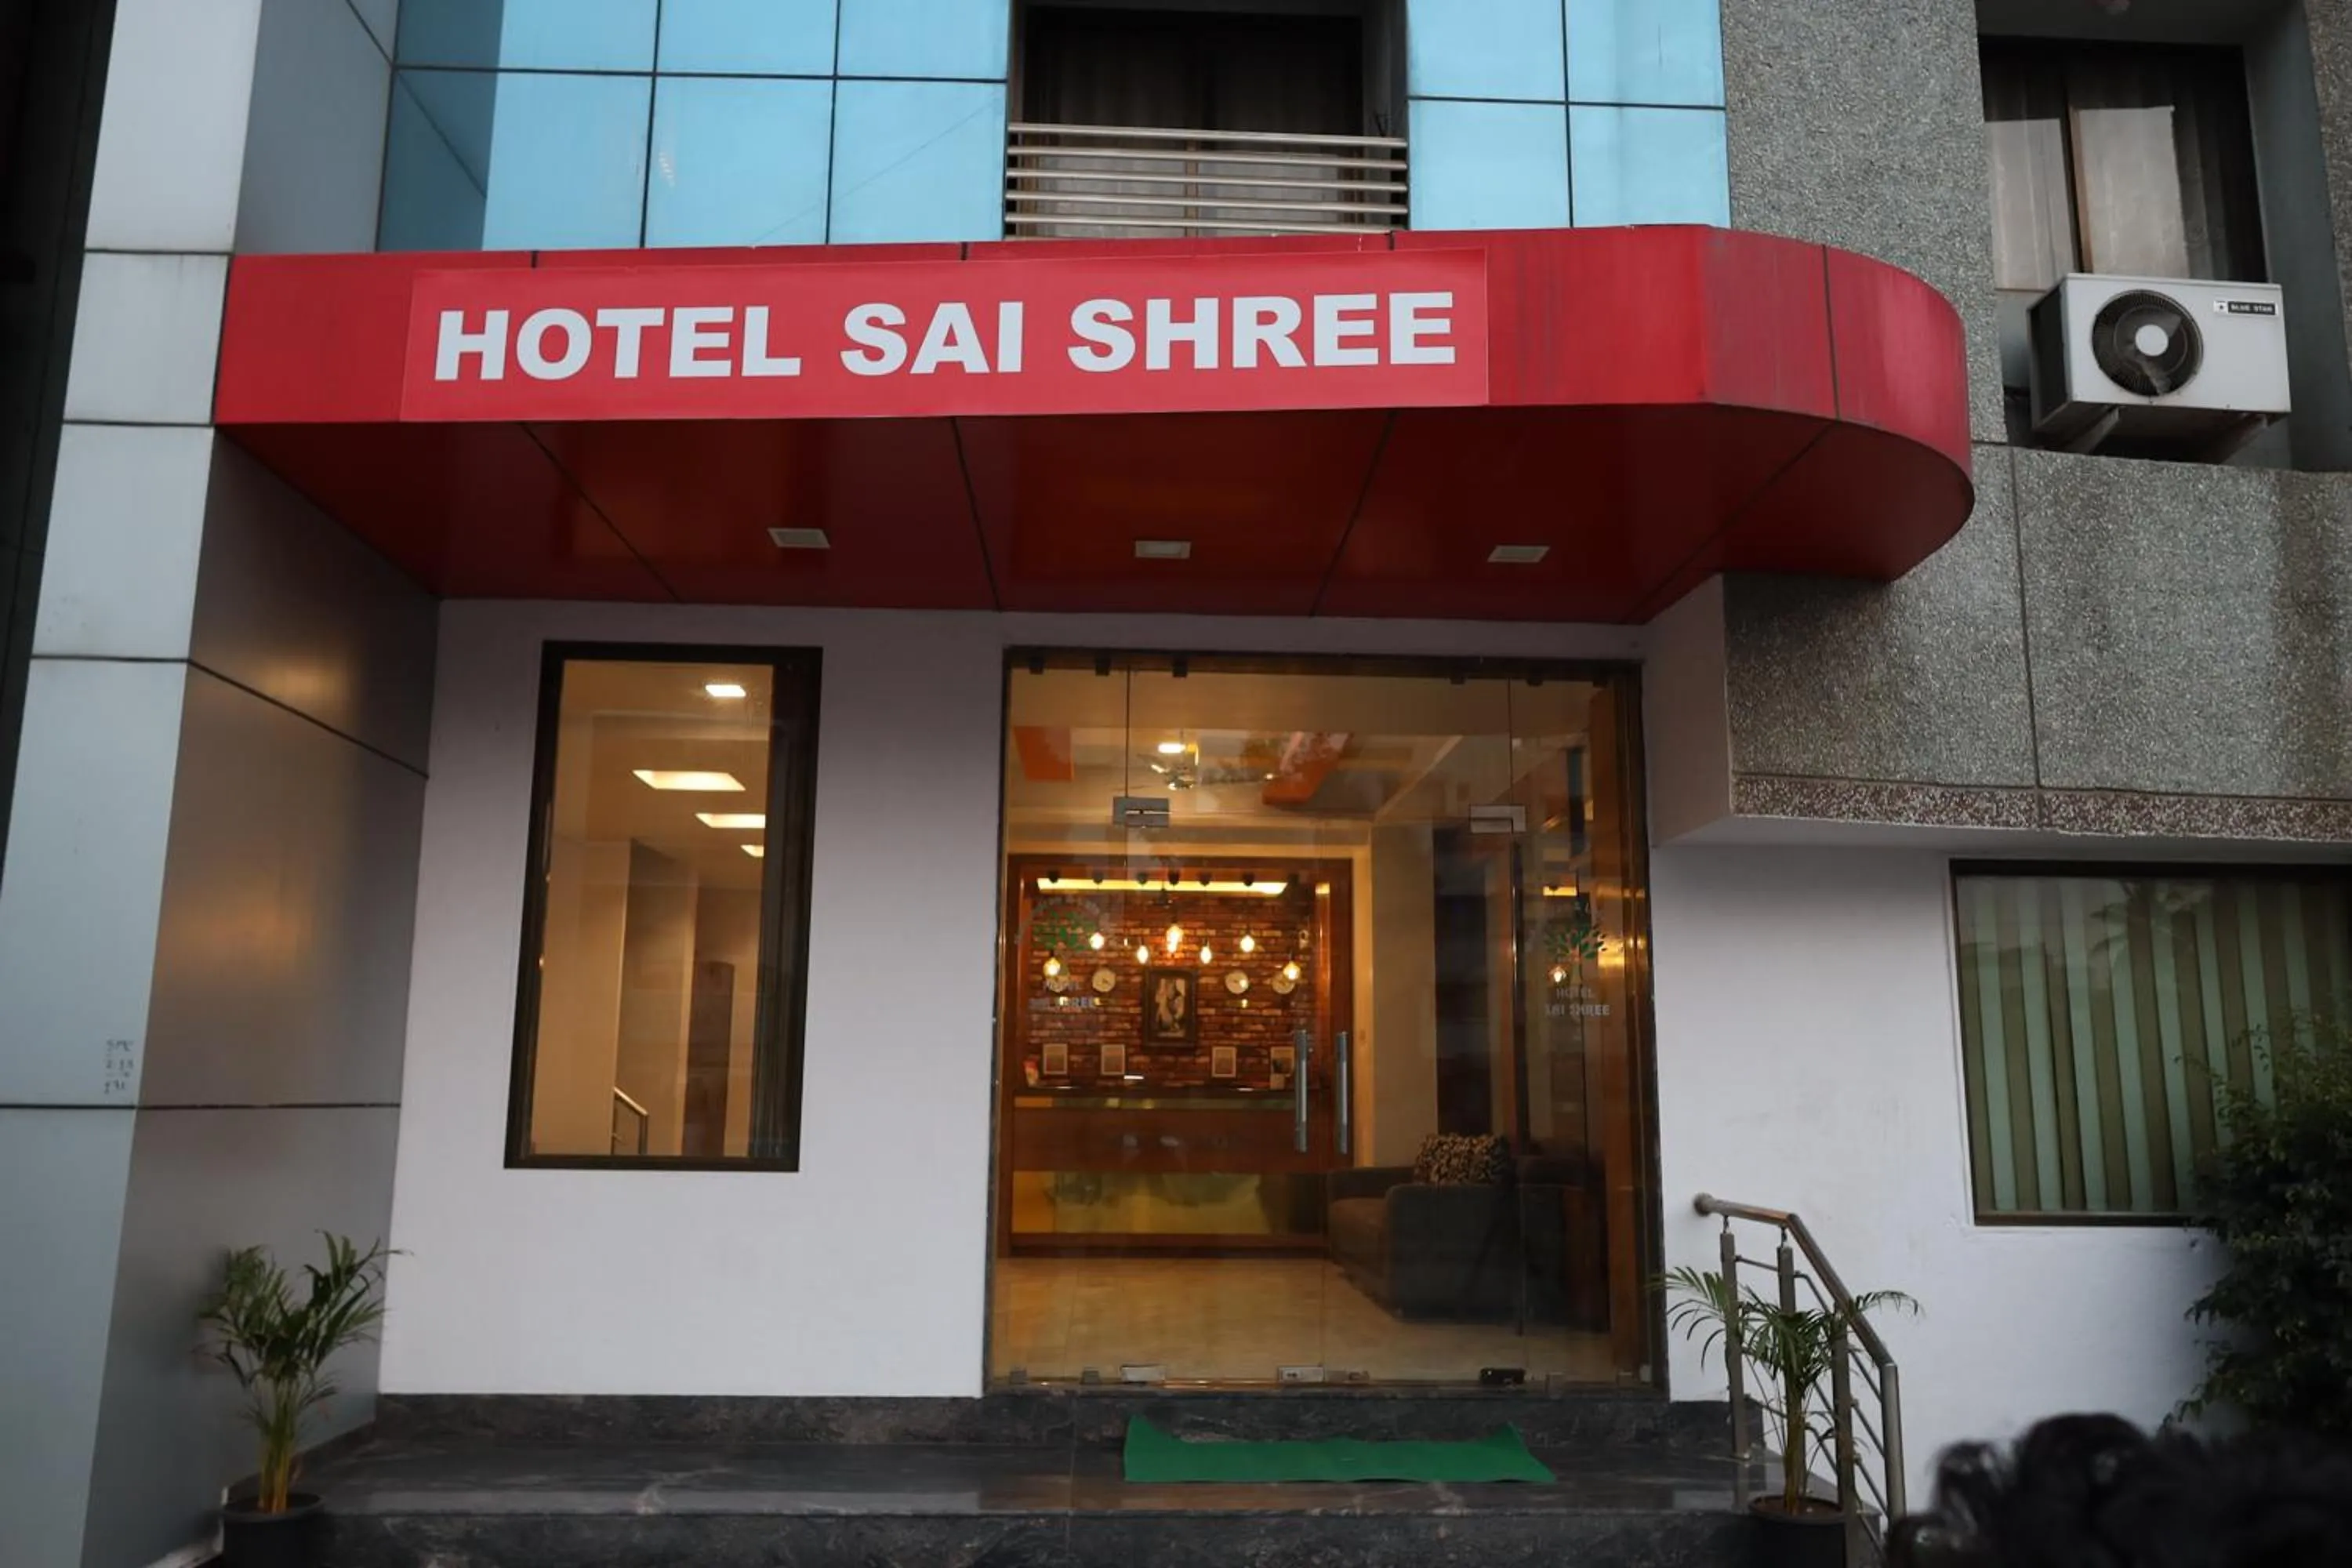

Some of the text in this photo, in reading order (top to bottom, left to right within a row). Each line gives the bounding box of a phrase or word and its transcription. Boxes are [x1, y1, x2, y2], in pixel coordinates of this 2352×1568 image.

[434, 291, 1457, 381] HOTEL SAI SHREE
